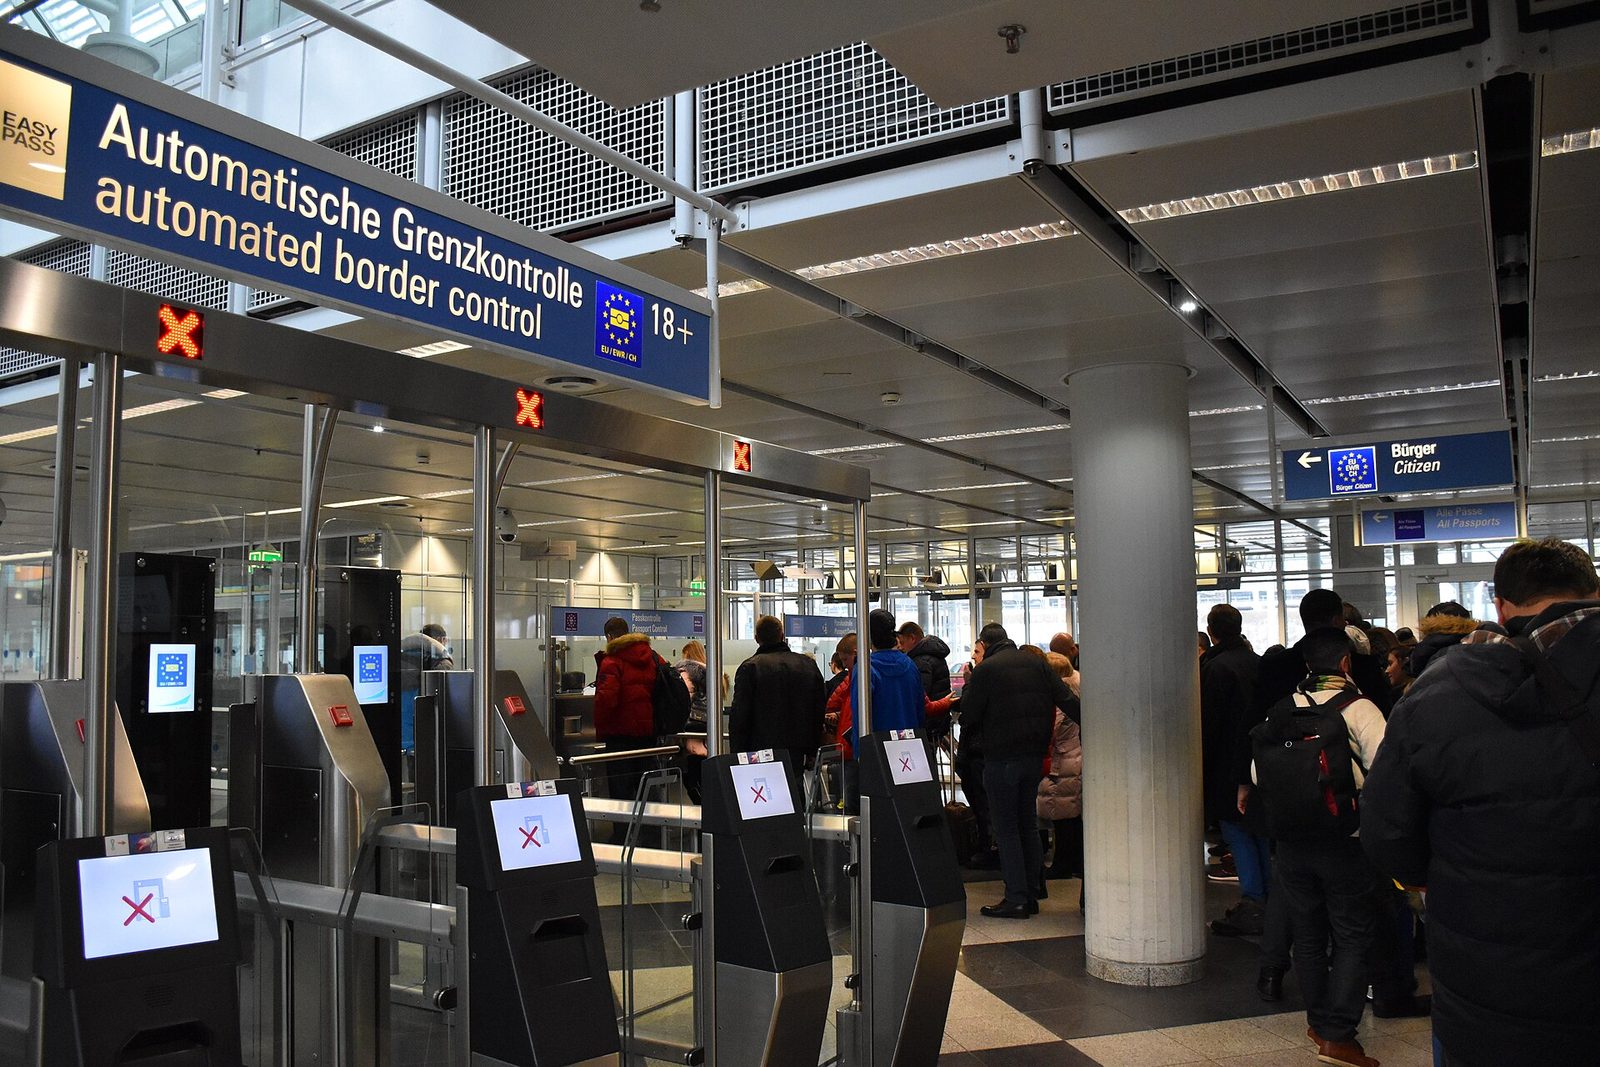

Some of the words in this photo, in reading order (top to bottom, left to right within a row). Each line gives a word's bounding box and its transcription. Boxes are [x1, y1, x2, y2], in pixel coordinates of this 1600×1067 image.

[3, 110, 58, 140] EASY
[2, 126, 56, 156] PASS
[98, 103, 381, 240] Automatische
[392, 207, 583, 308] Grenzkontrolle
[96, 177, 322, 275] automated
[334, 238, 440, 309] border
[448, 286, 542, 340] control
[651, 303, 694, 345] 18+
[1391, 443, 1437, 459] Bürger
[1394, 459, 1441, 475] Citizen
[1437, 519, 1450, 528] All
[1452, 517, 1501, 529] Passports
